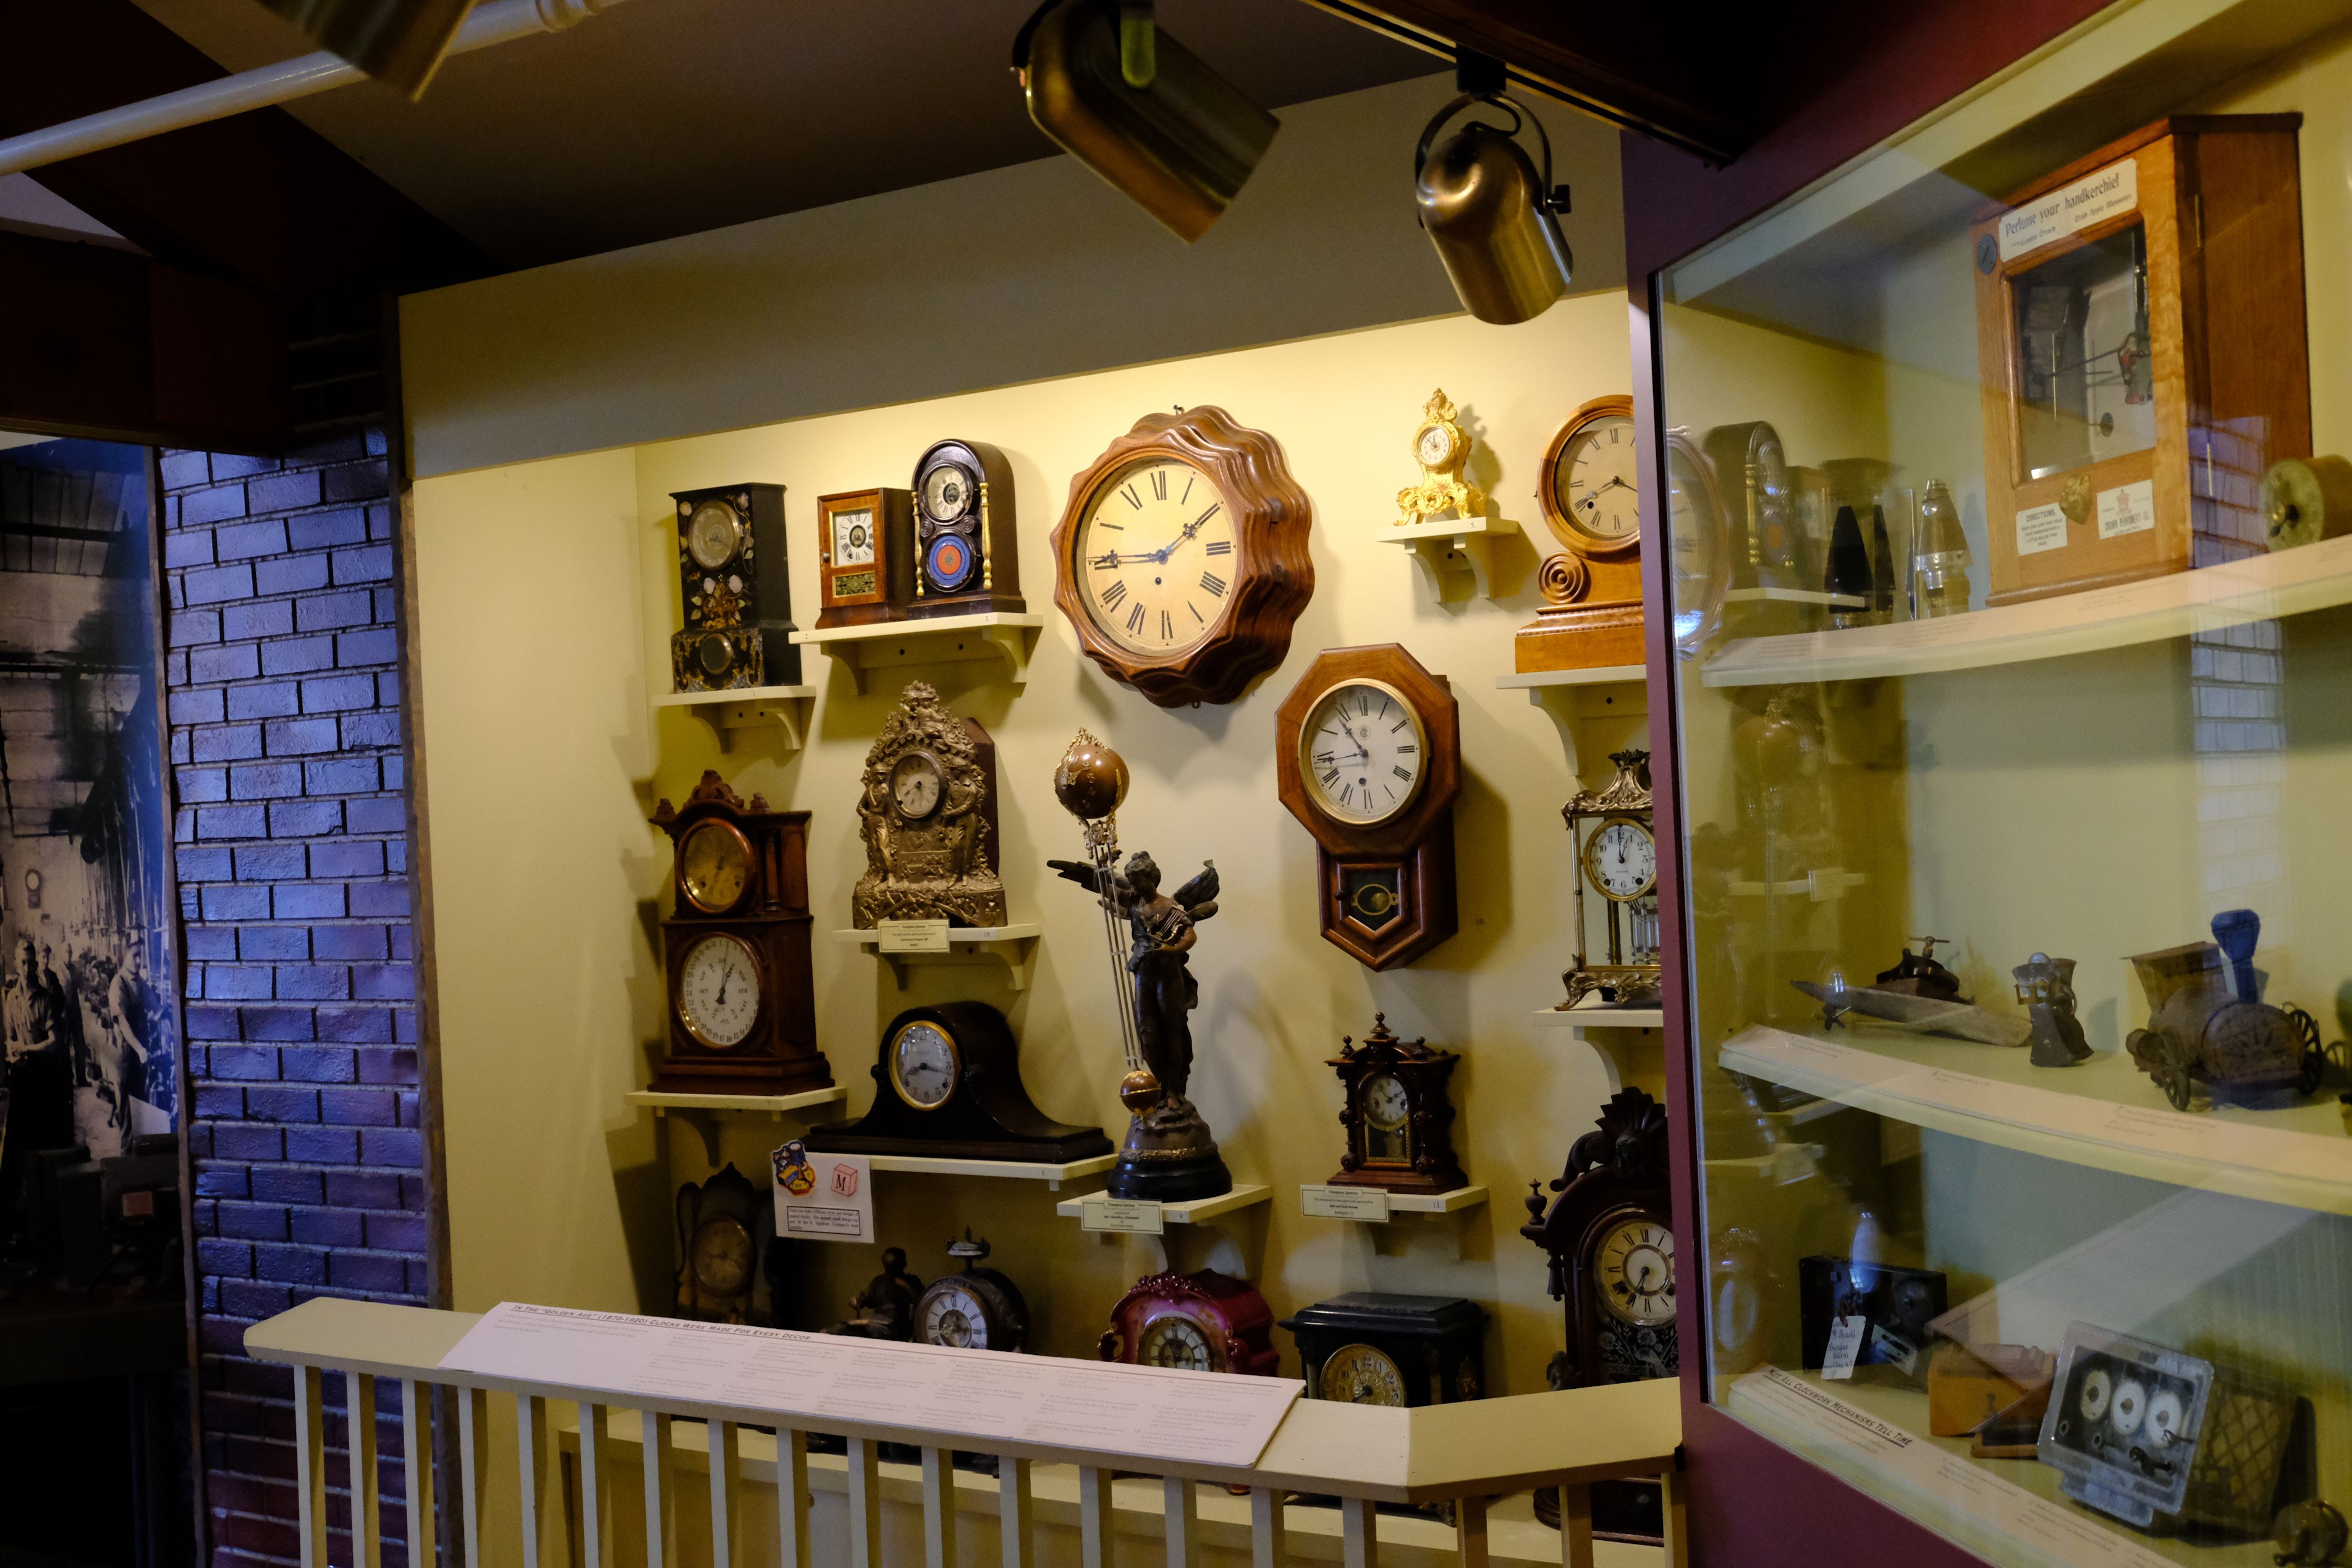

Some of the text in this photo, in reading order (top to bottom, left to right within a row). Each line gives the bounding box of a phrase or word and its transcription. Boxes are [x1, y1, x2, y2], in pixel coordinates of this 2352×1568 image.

[2005, 172, 2120, 237] Perfume your handkerchief
[1149, 470, 1167, 501] XII
[1120, 483, 1143, 511] XI
[2026, 508, 2057, 522] DIRECTIONS
[1206, 541, 1231, 556] III
[1101, 580, 1128, 614] VIII
[1126, 602, 1146, 636] VII
[1161, 609, 1174, 640] VI
[1335, 702, 1351, 722] XI
[1357, 696, 1368, 716] XII
[1391, 719, 1407, 734] II
[1397, 745, 1415, 754] III
[1322, 767, 1341, 790] VIII
[1339, 783, 1354, 806] VII
[1363, 789, 1373, 809] VI
[1607, 835, 1613, 843] 11
[1638, 842, 1643, 851] 2
[1642, 854, 1648, 863] 3
[1610, 879, 1615, 887] 7
[1620, 880, 1627, 888] 6
[835, 1173, 846, 1191] M
[1640, 1229, 1649, 1242] XII
[598, 1314, 647, 1324] (1870-1920)
[649, 1320, 680, 1328] CLOCKS
[1769, 1369, 1782, 1379] NOT
[1782, 1377, 1792, 1386] ALL
[1793, 1383, 1831, 1405] CLOCKWORK
[1832, 1402, 1874, 1427] MECHANISMS
[1875, 1423, 1891, 1436] TELL
[1893, 1433, 1914, 1446] TIME
